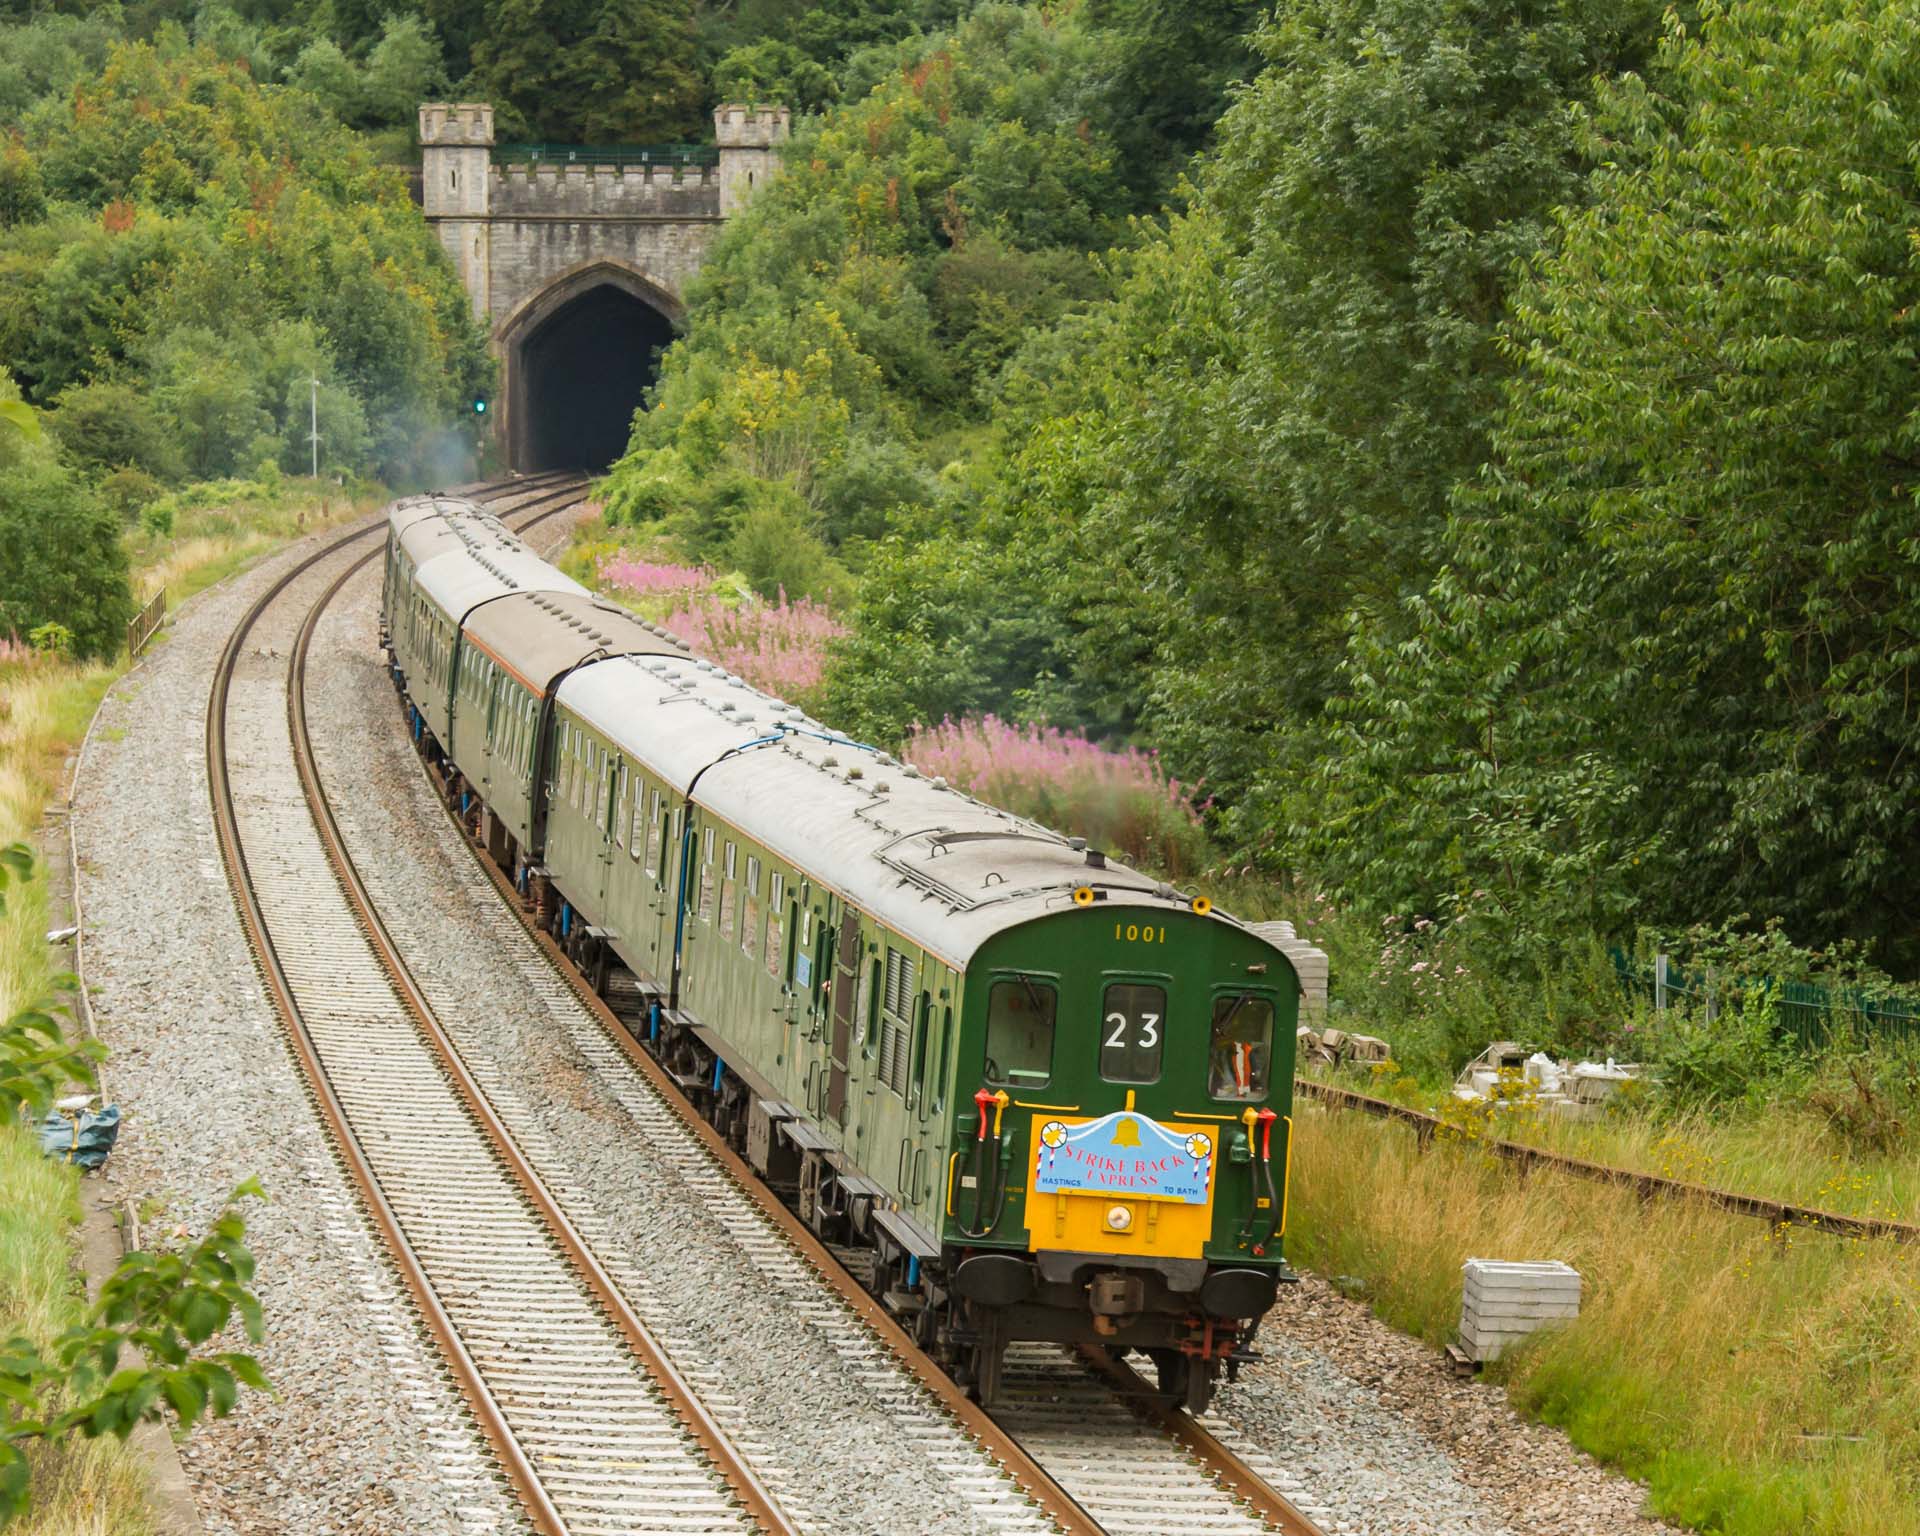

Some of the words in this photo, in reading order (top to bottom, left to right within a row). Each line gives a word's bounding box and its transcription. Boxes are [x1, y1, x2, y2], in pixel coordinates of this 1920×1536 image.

[1115, 924, 1165, 944] 1001
[1065, 1144, 1126, 1173] STRIKE
[1135, 1154, 1185, 1173] BACK
[1041, 1177, 1082, 1187] HASTINGS
[1163, 1186, 1174, 1194] TO
[1177, 1187, 1198, 1195] BATH
[1087, 1170, 1158, 1187] EXPRESS
